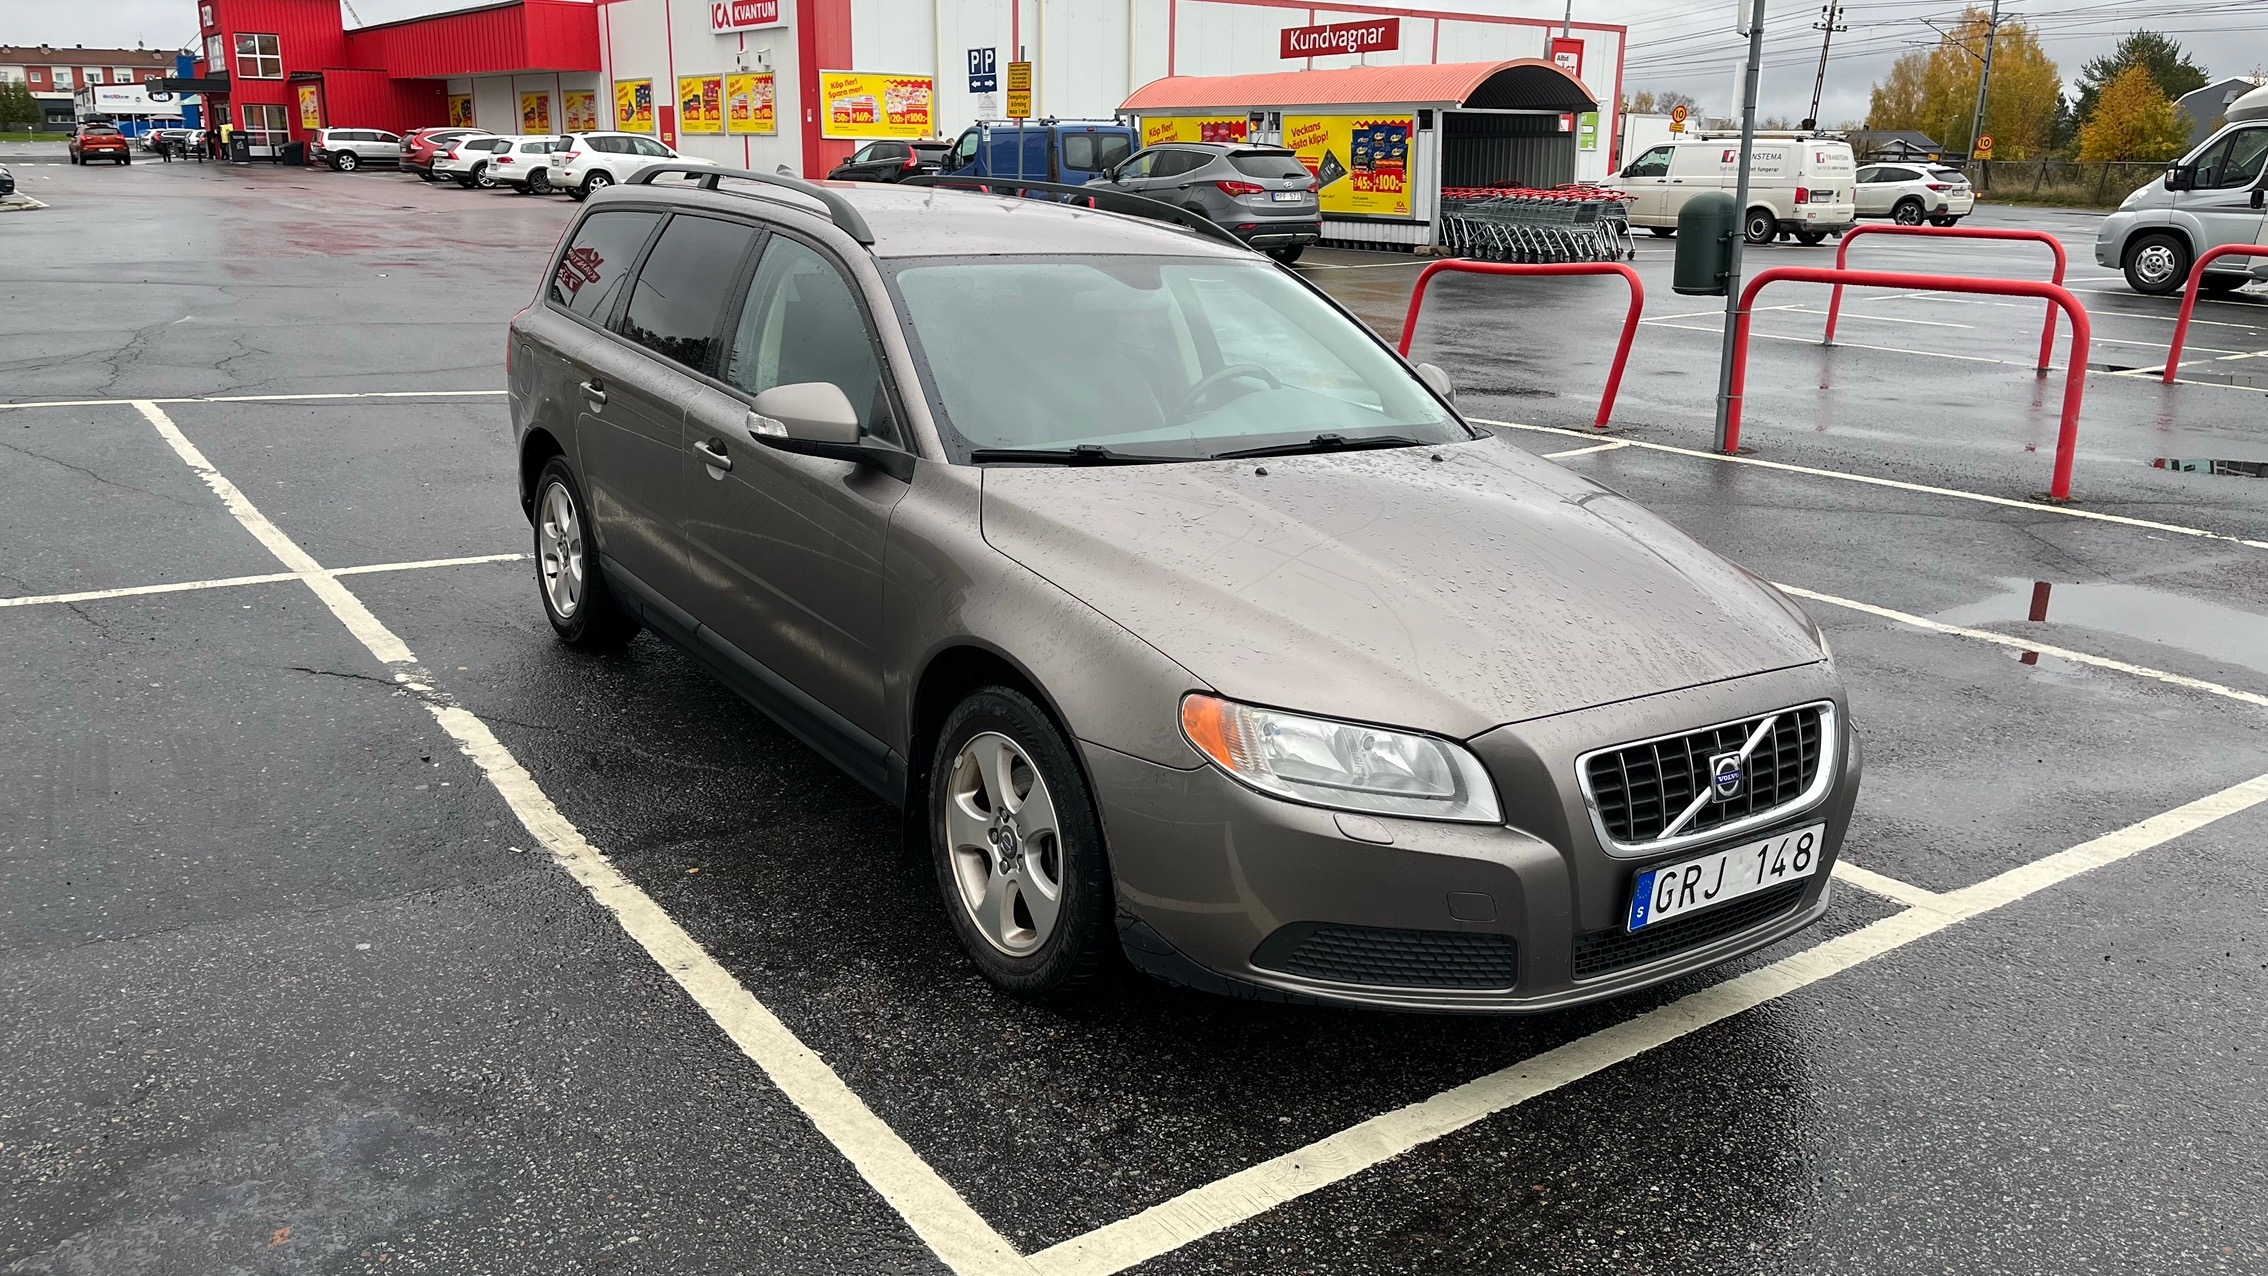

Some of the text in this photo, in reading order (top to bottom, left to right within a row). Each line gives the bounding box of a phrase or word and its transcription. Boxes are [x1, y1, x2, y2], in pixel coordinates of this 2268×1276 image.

[711, 1, 776, 29] ICA KVANTUM
[1290, 25, 1385, 52] Kundvagnar
[971, 50, 994, 73] P P
[830, 78, 858, 90] Köp fler!
[828, 85, 864, 99] Spara mer!
[1676, 110, 1684, 118] 10
[1149, 121, 1174, 138] Köp fler!
[1291, 122, 1321, 138] Veckans
[1165, 132, 1178, 142] mer!
[1287, 131, 1329, 149] bästa klipp!
[1980, 138, 1990, 147] 10
[1358, 176, 1373, 190] 45:-
[1379, 175, 1401, 190] 100:-
[1718, 772, 1740, 782] VOLVO
[1655, 831, 1814, 914] GRJ 148
[1636, 905, 1645, 918] S
